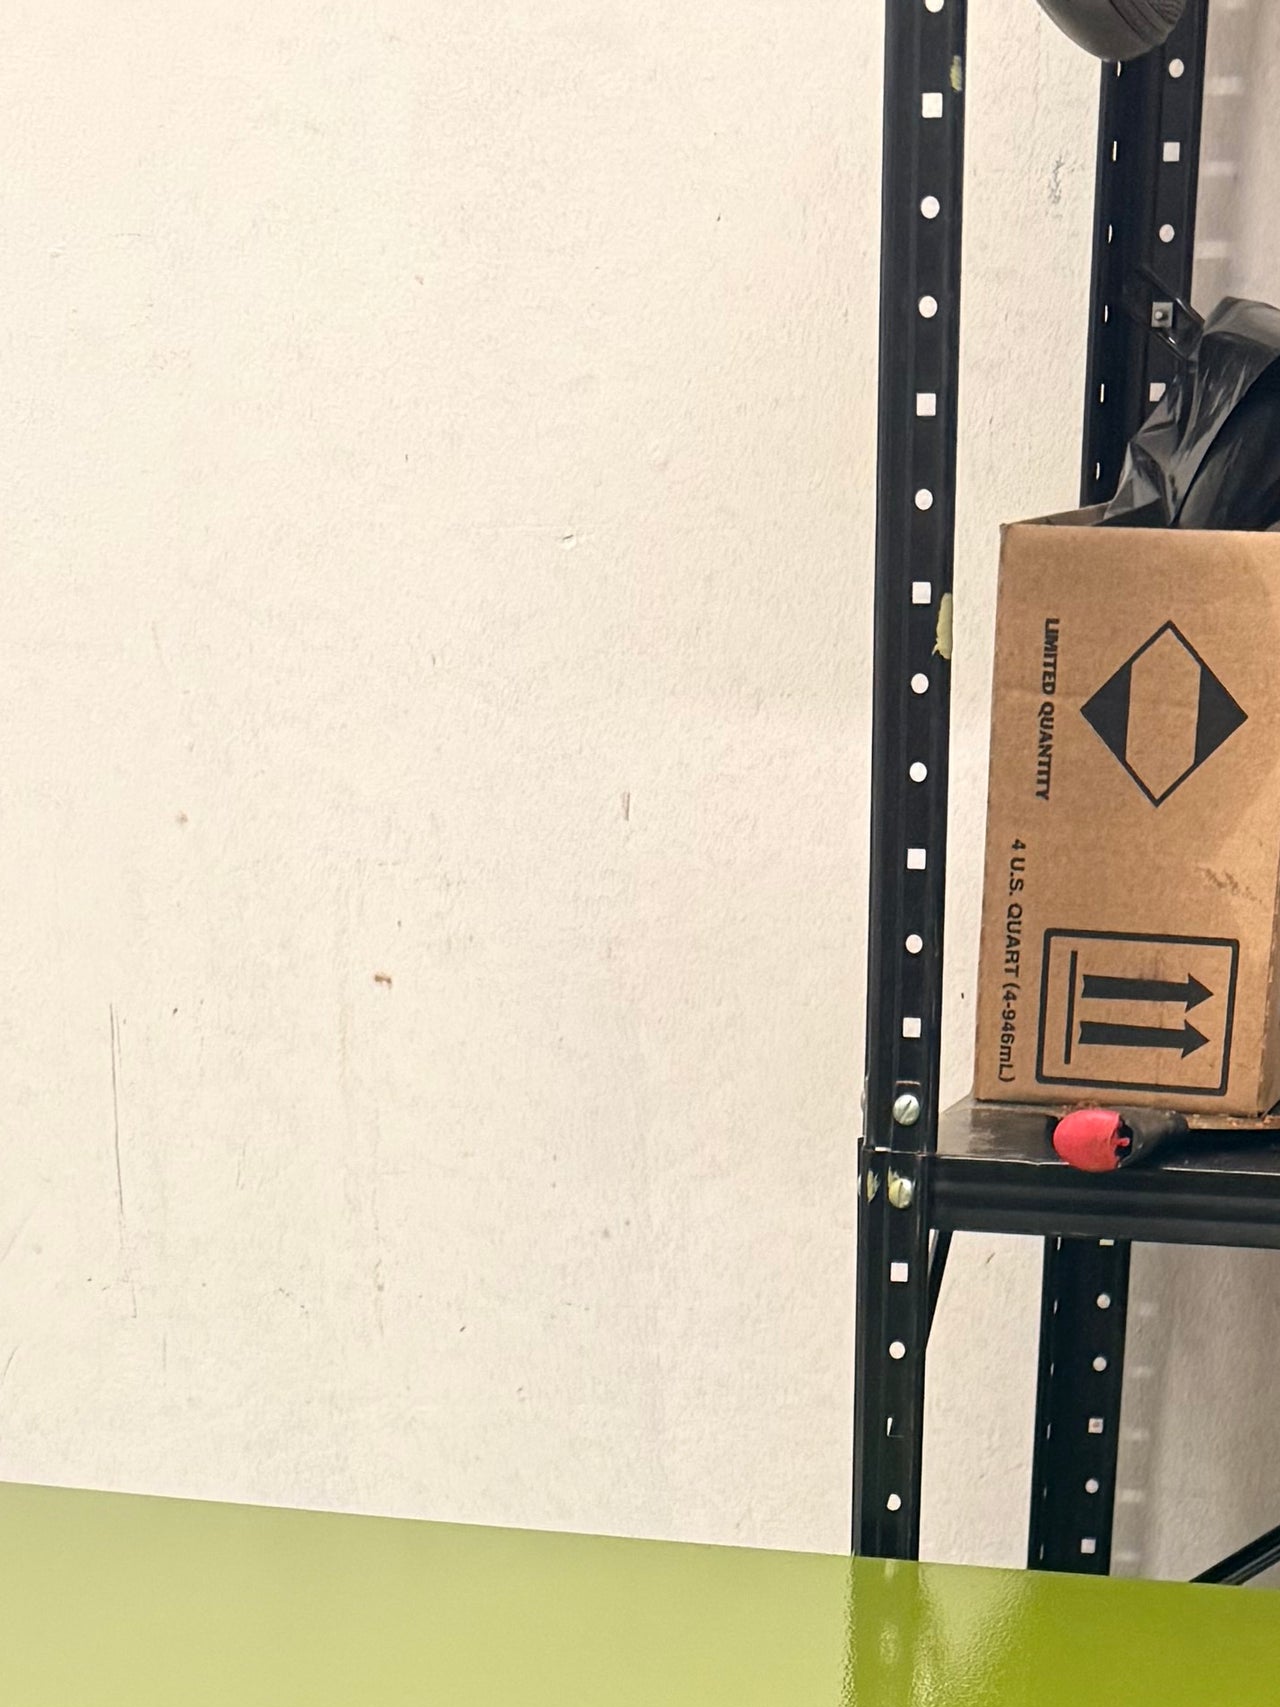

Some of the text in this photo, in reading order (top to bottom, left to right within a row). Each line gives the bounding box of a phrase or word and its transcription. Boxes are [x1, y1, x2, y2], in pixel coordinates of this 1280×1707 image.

[1035, 618, 1060, 801] LIMITED QUANTITY
[998, 838, 1026, 1083] 4 U.S. QUART (4-946mL)
